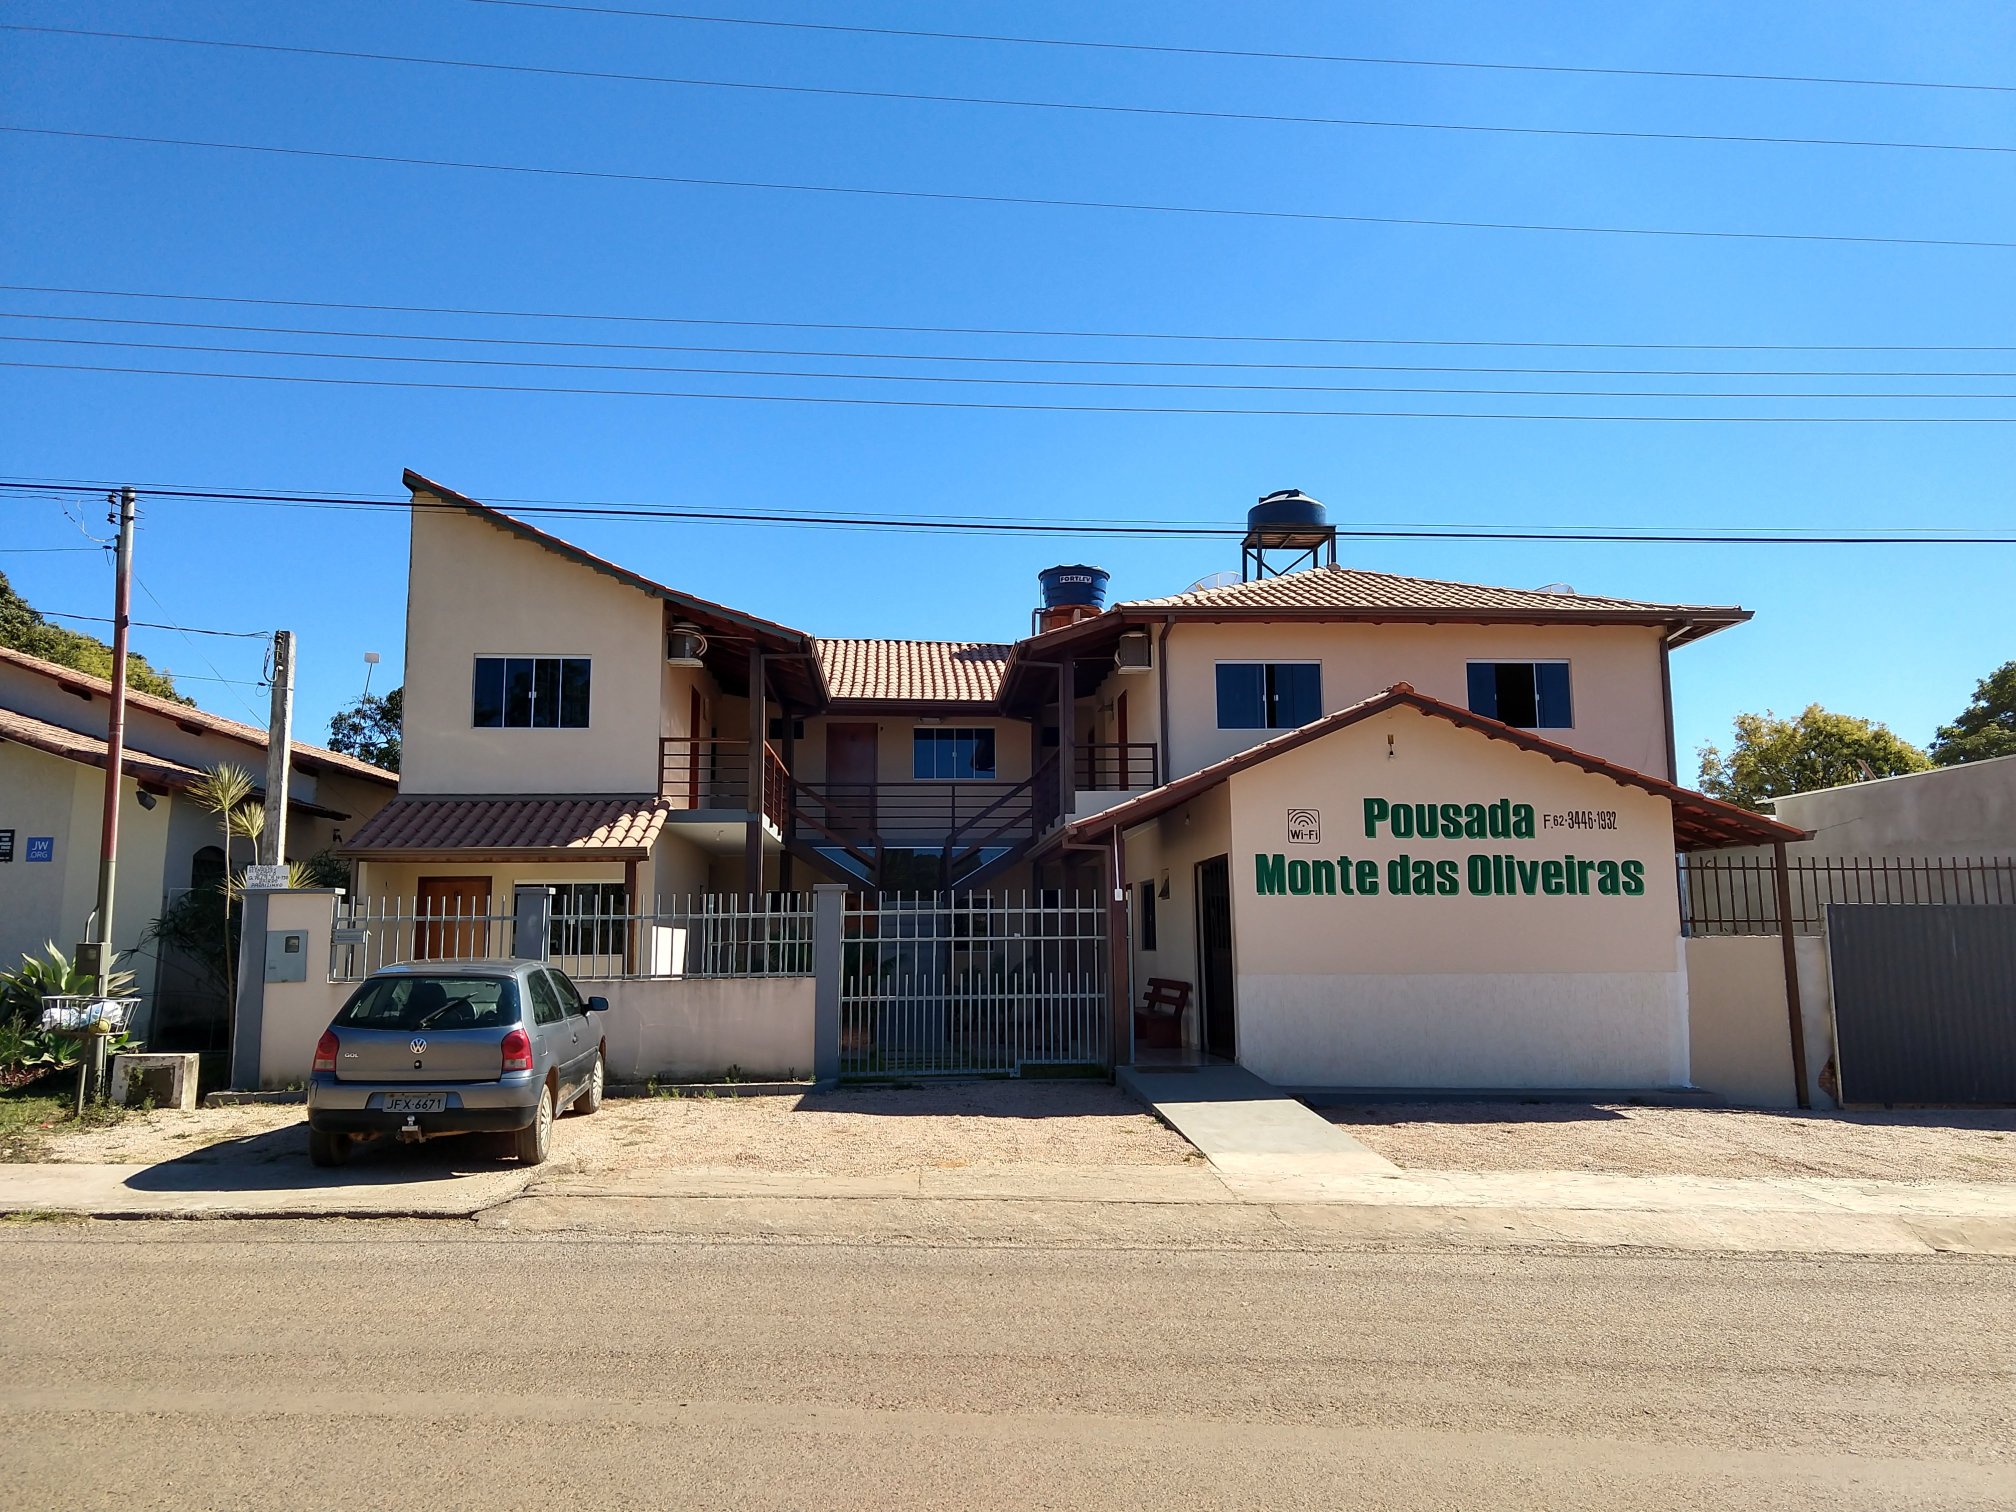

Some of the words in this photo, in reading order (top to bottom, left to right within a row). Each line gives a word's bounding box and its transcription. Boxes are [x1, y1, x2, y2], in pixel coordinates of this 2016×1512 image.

[1363, 797, 1536, 839] Pousada
[31, 841, 49, 850] JW
[1290, 829, 1318, 840] Wi-Fi
[1255, 853, 1380, 896] Monte
[1387, 854, 1460, 896] das
[1467, 854, 1646, 896] Oliveiras
